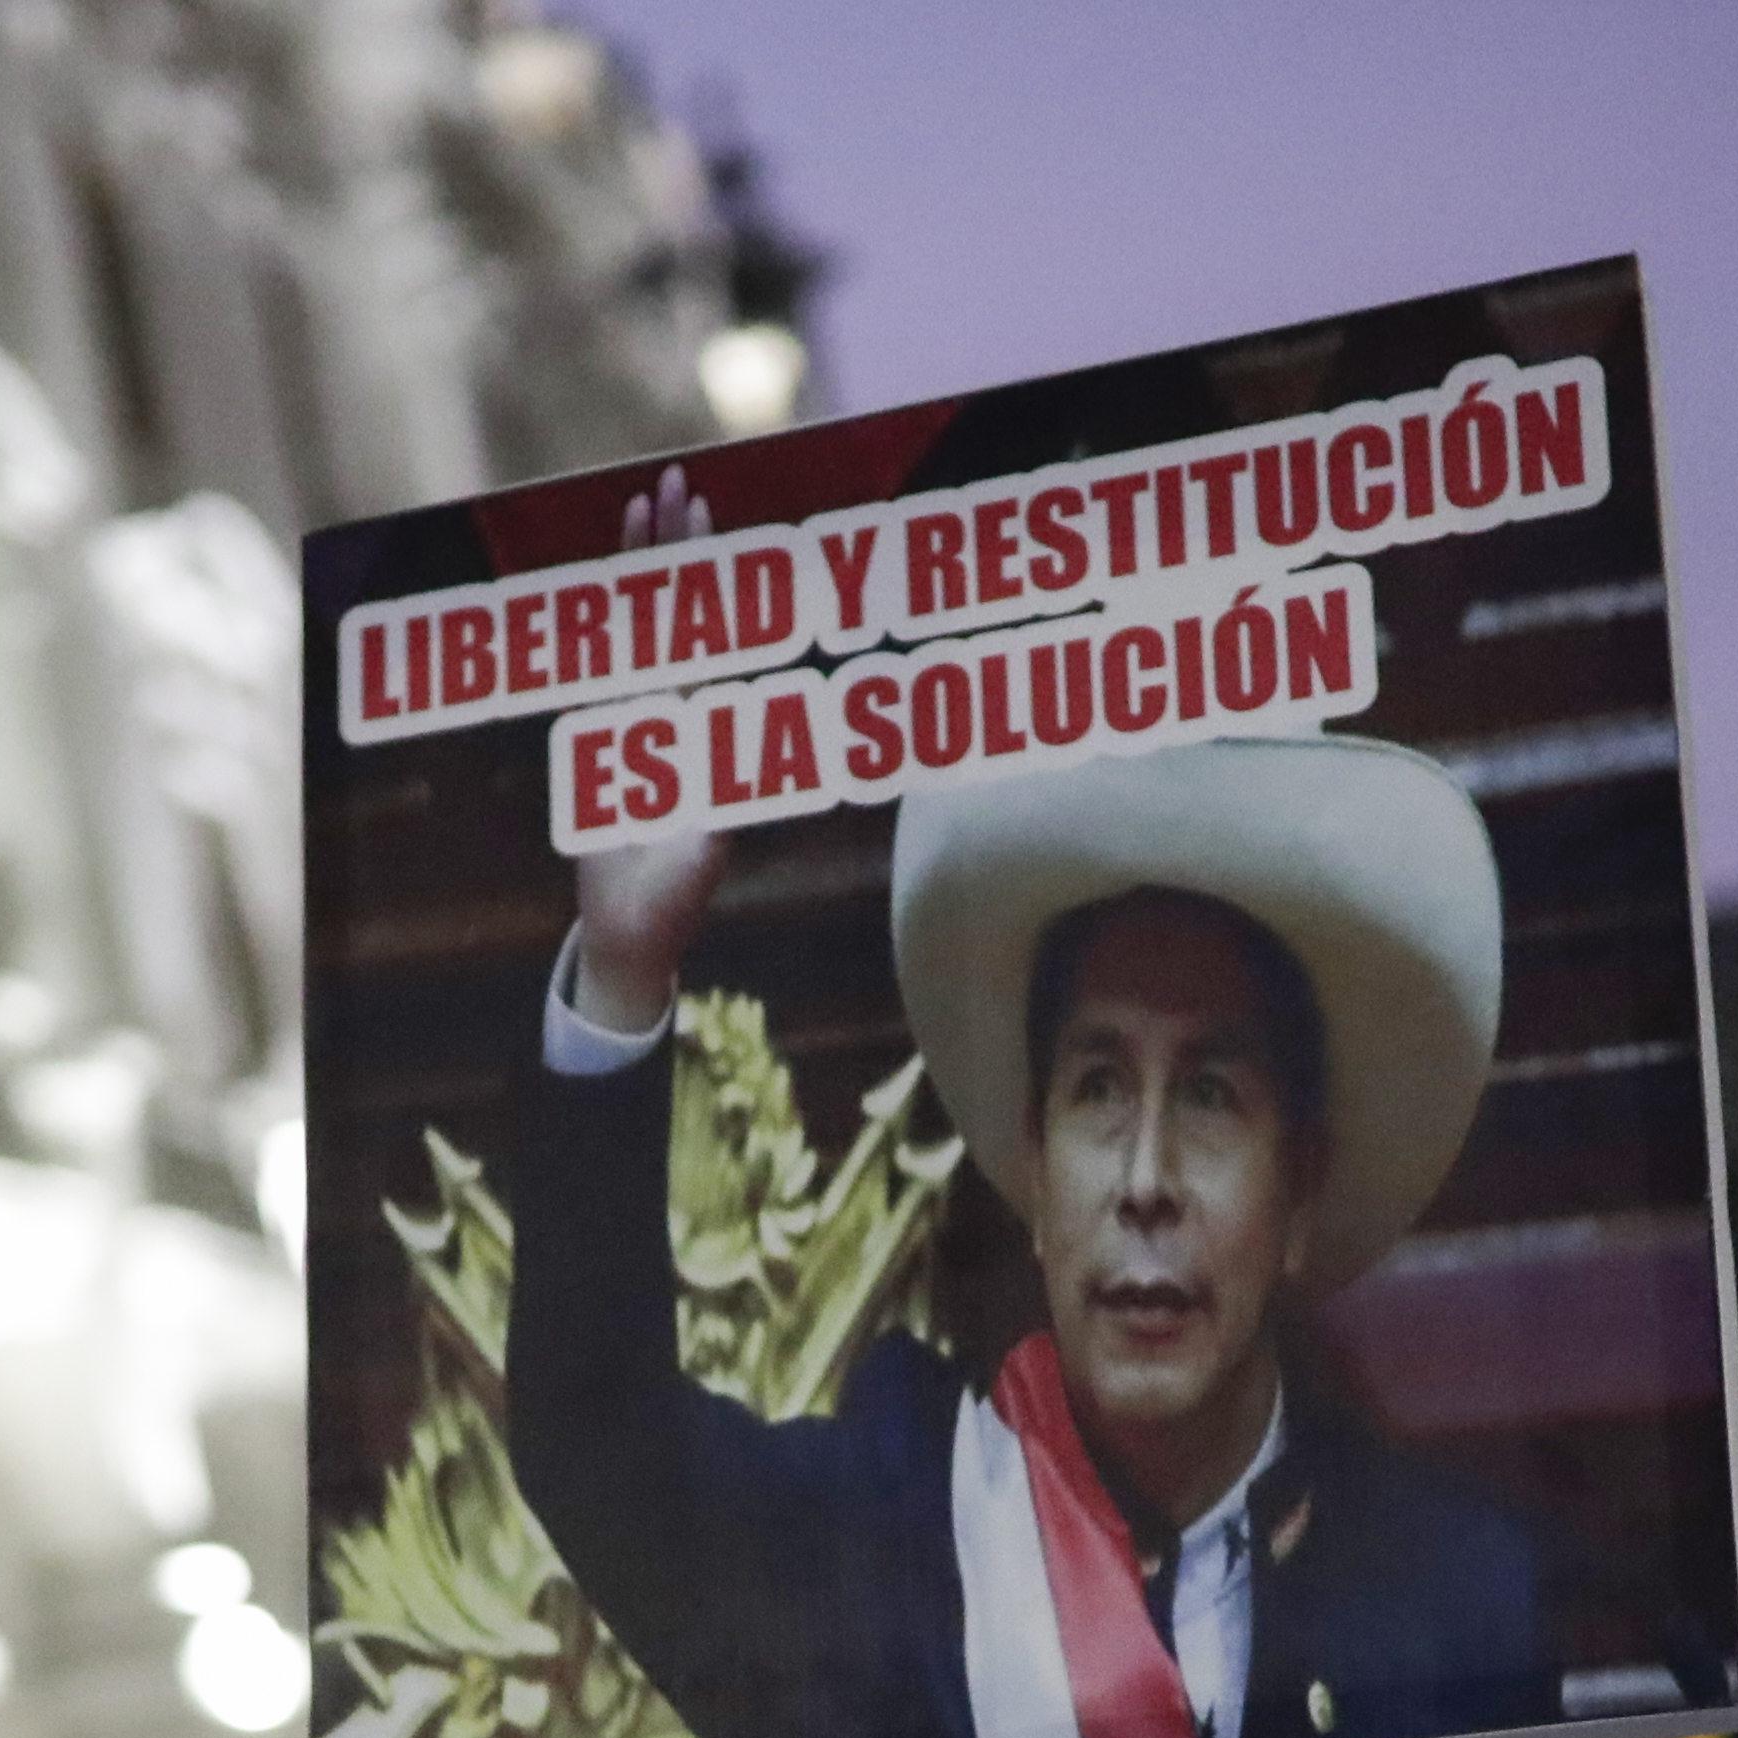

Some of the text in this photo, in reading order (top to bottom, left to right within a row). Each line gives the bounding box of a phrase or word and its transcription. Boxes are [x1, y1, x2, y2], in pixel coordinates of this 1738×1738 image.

[360, 382, 1586, 722] LIBERTAD Y RESTITUCIÓN
[572, 585, 1353, 832] ES LA SOLUCIÓN
